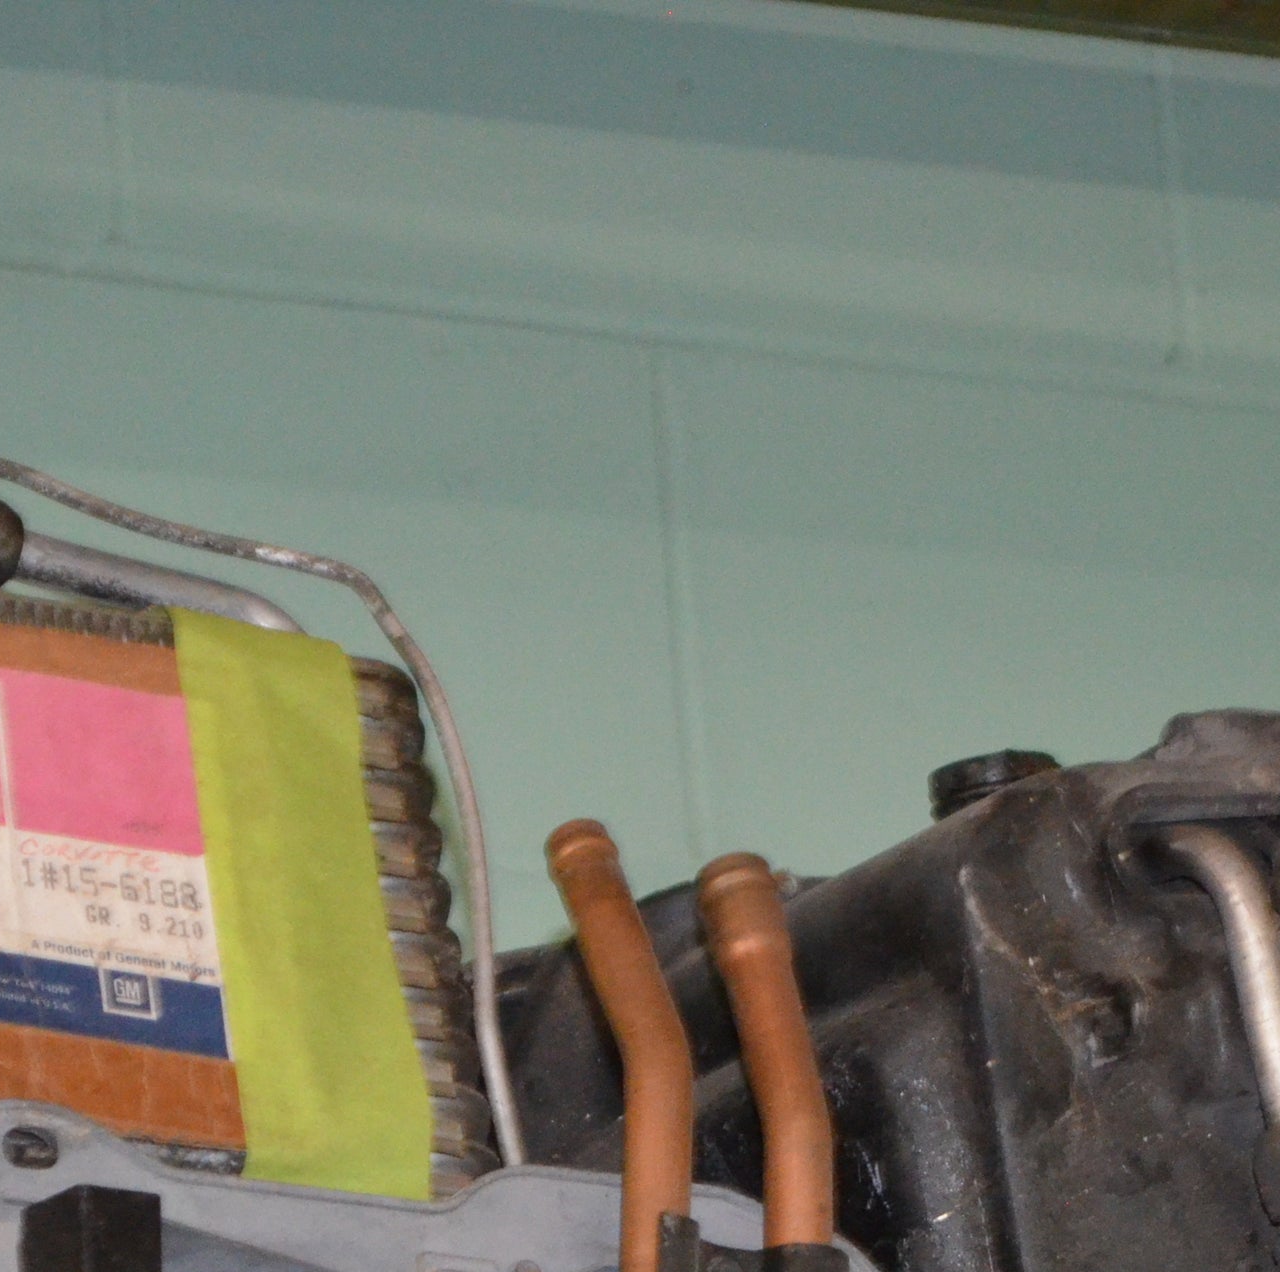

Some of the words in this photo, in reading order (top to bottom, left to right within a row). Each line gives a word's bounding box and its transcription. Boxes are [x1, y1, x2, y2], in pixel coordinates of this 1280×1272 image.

[31, 939, 40, 949] A
[44, 942, 94, 959] Product
[98, 951, 111, 961] of
[115, 951, 166, 970] General
[170, 961, 217, 978] Motors
[114, 978, 141, 1001] GM
